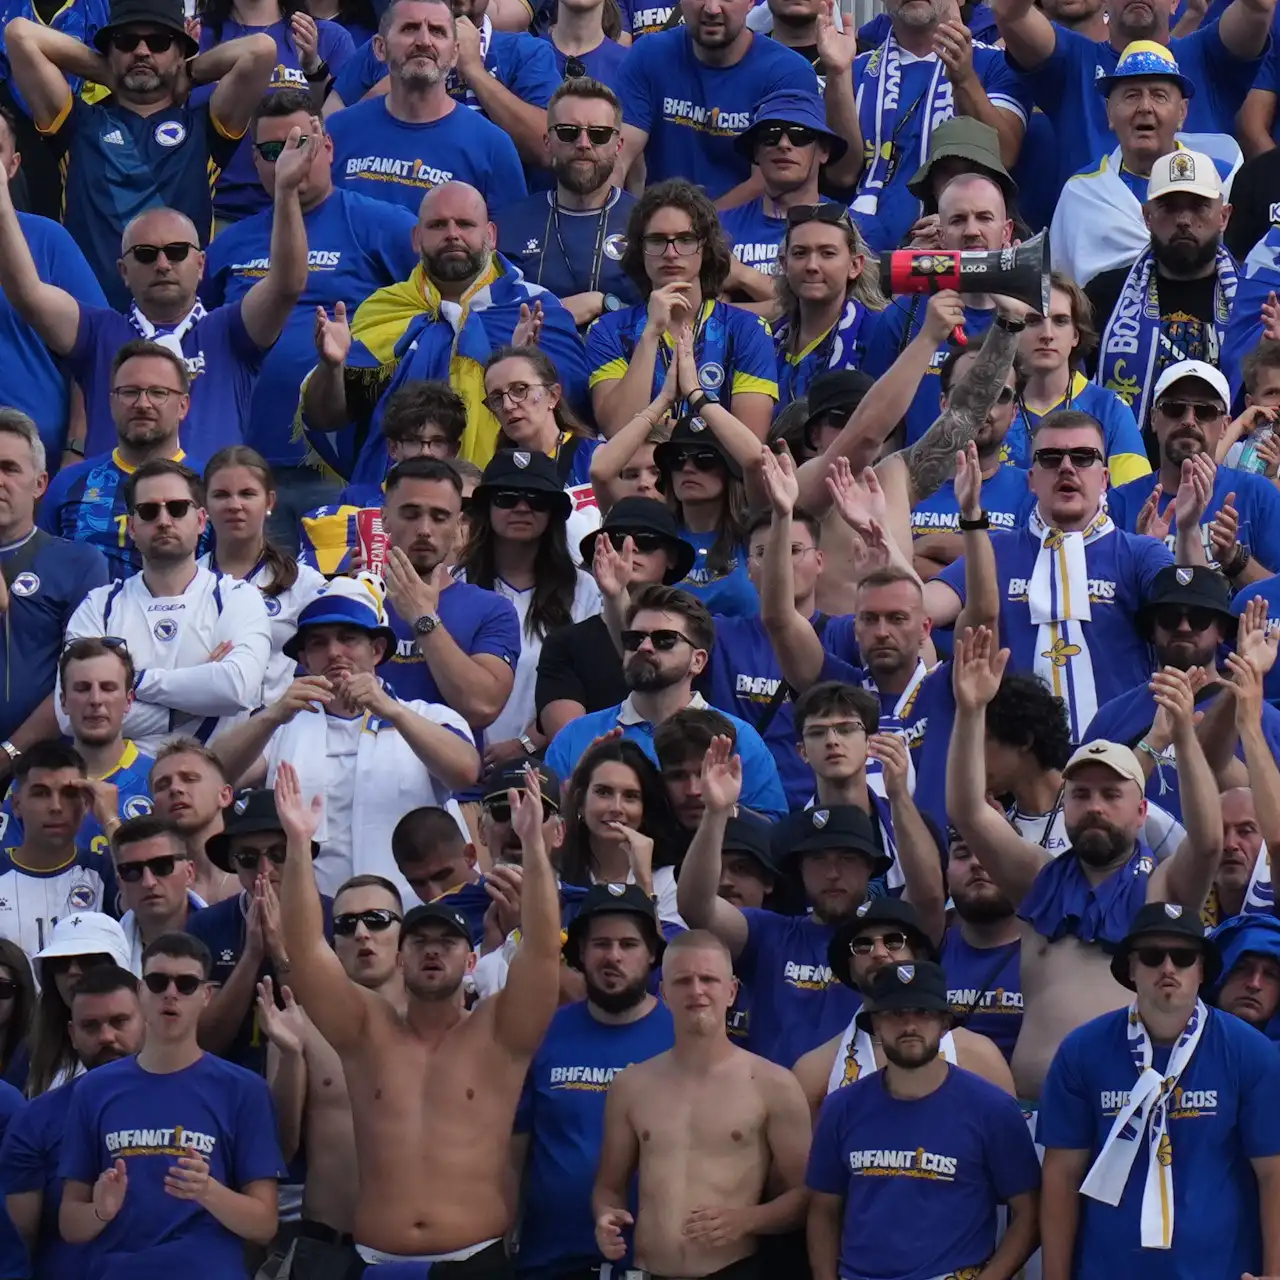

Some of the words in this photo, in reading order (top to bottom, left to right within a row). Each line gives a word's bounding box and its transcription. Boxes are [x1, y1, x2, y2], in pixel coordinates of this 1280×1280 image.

[147, 603, 187, 613] LEGEA
[105, 1125, 217, 1154] BHFANATICOS
[849, 1148, 958, 1176] BHFANATICOS
